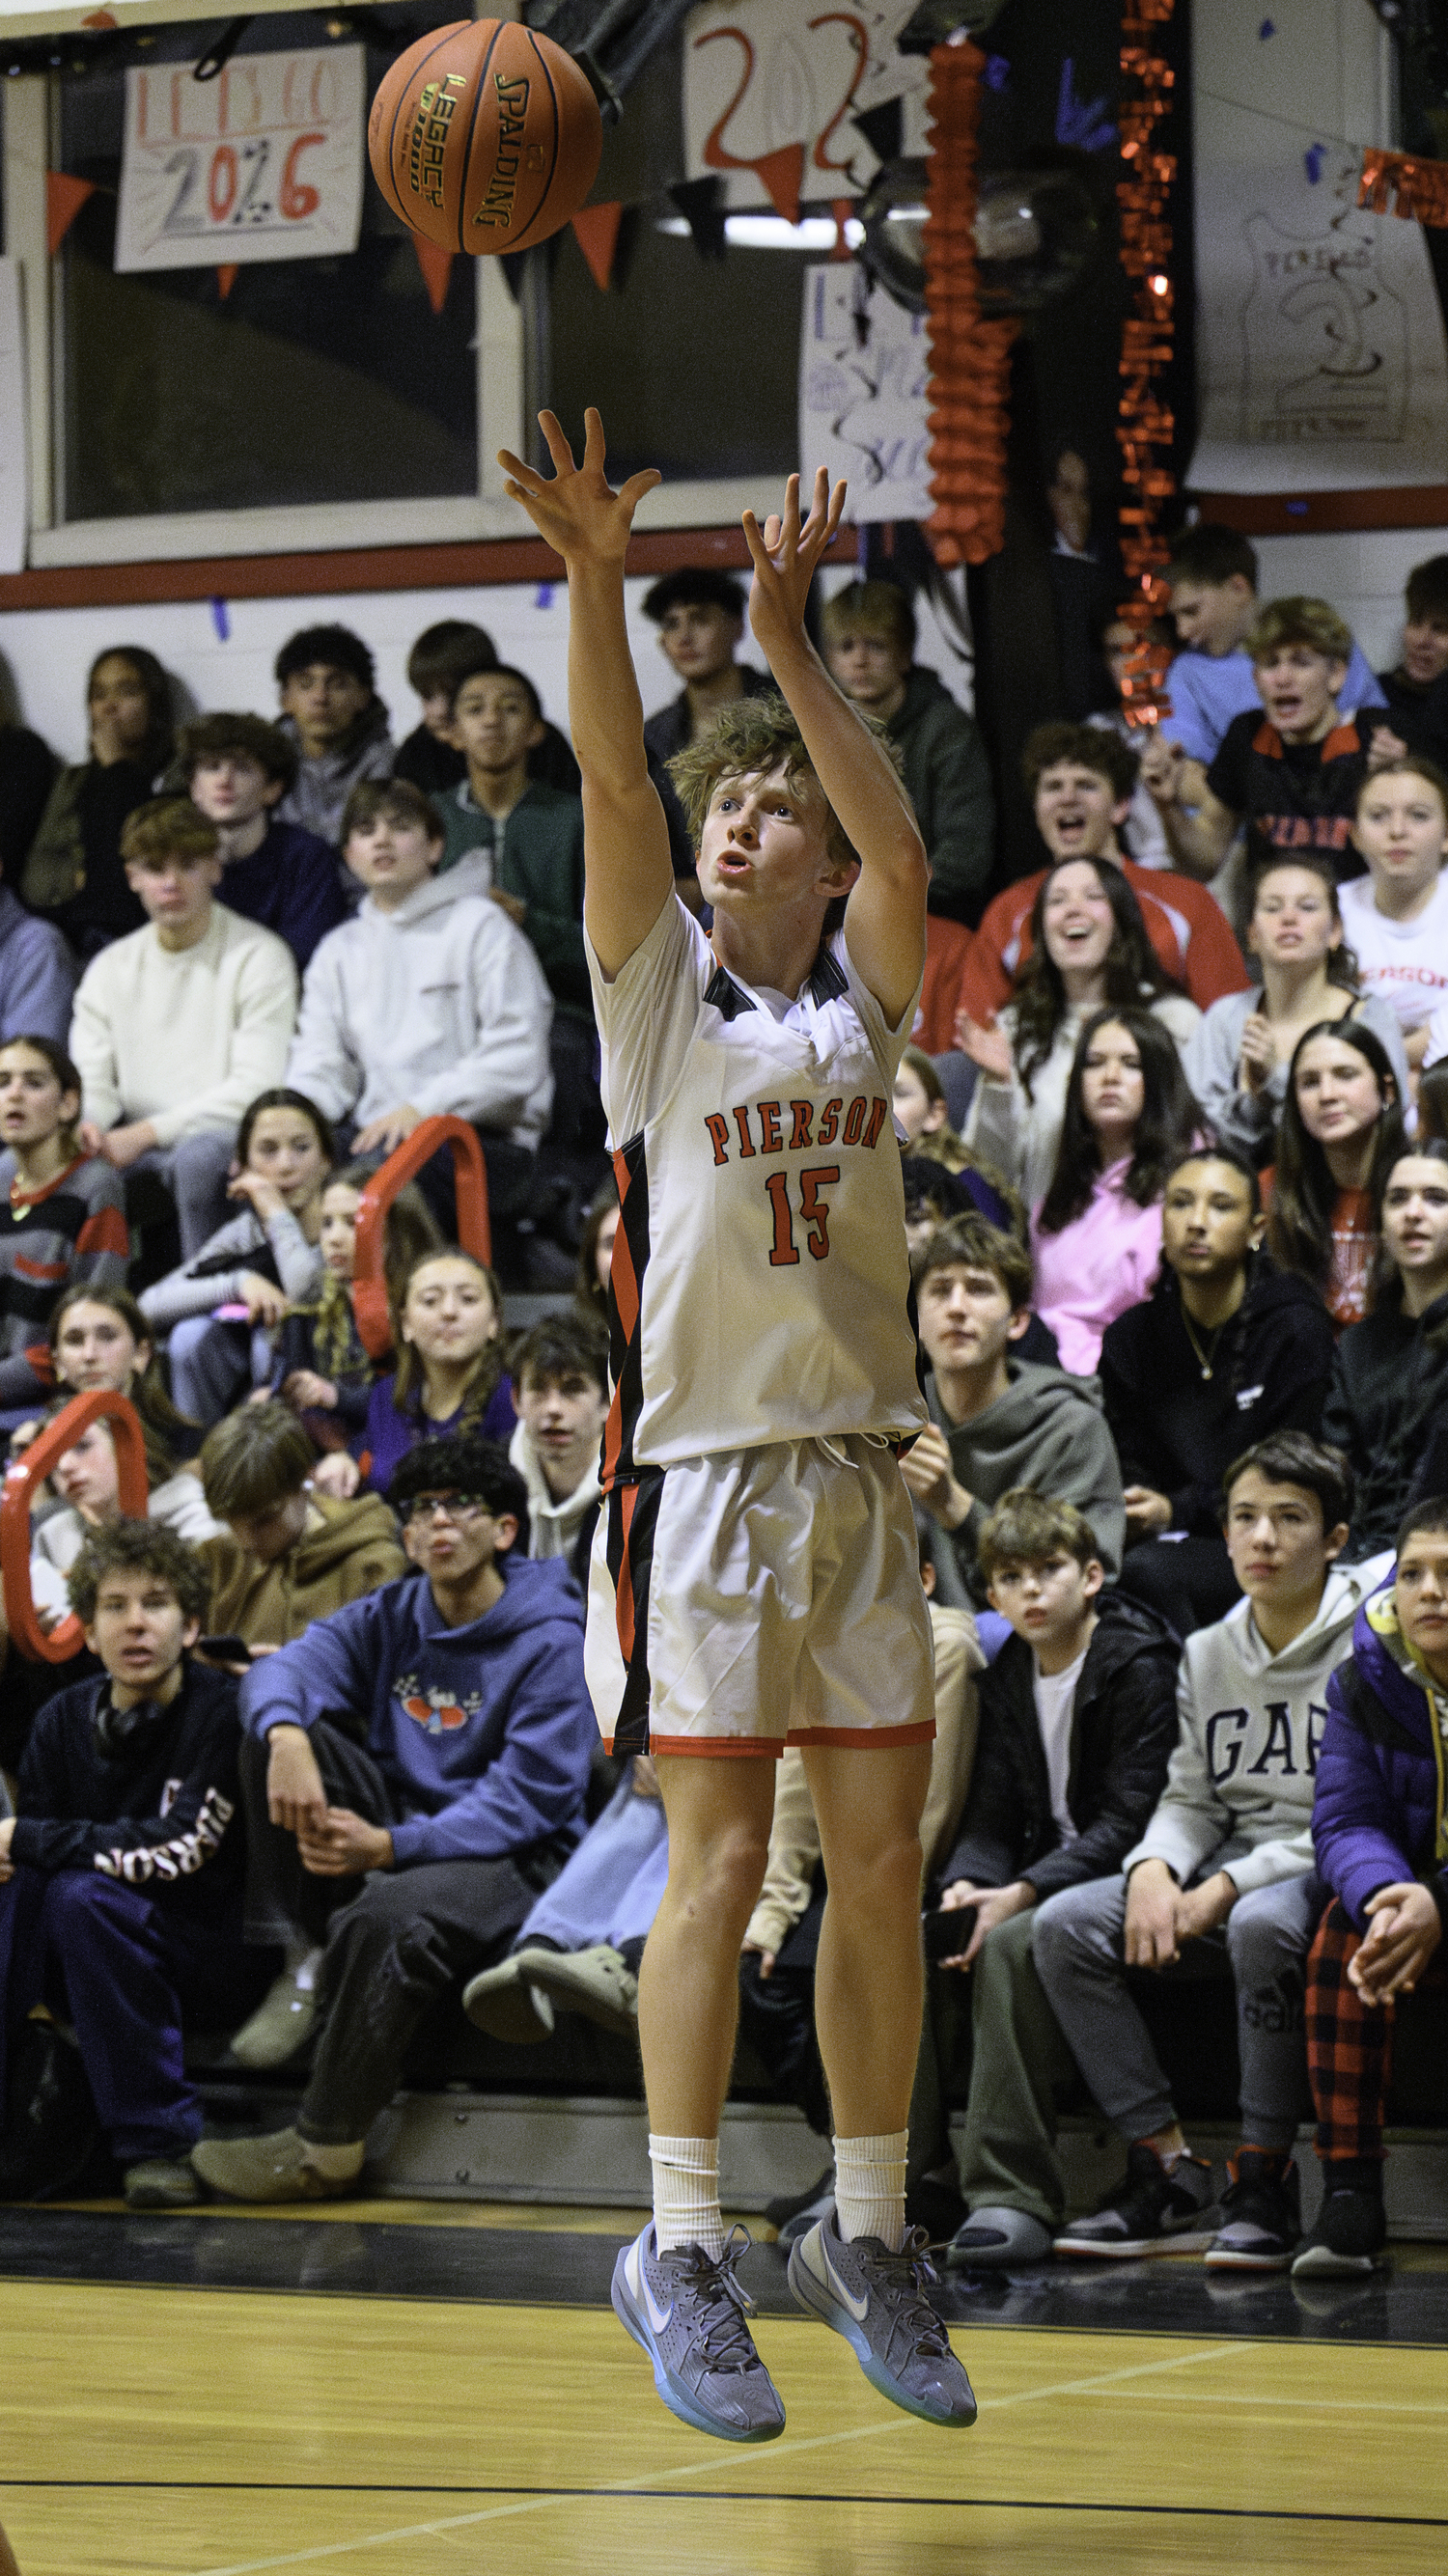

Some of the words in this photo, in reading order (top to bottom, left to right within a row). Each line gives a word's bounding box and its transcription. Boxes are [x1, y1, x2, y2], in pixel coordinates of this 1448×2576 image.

[162, 132, 329, 232] 2026
[425, 73, 467, 209] LEGACY
[472, 73, 530, 229] SPALDING
[704, 1095, 888, 1167] PIERSON
[766, 1165, 841, 1267] 15
[1243, 2003, 1304, 2034] adi
